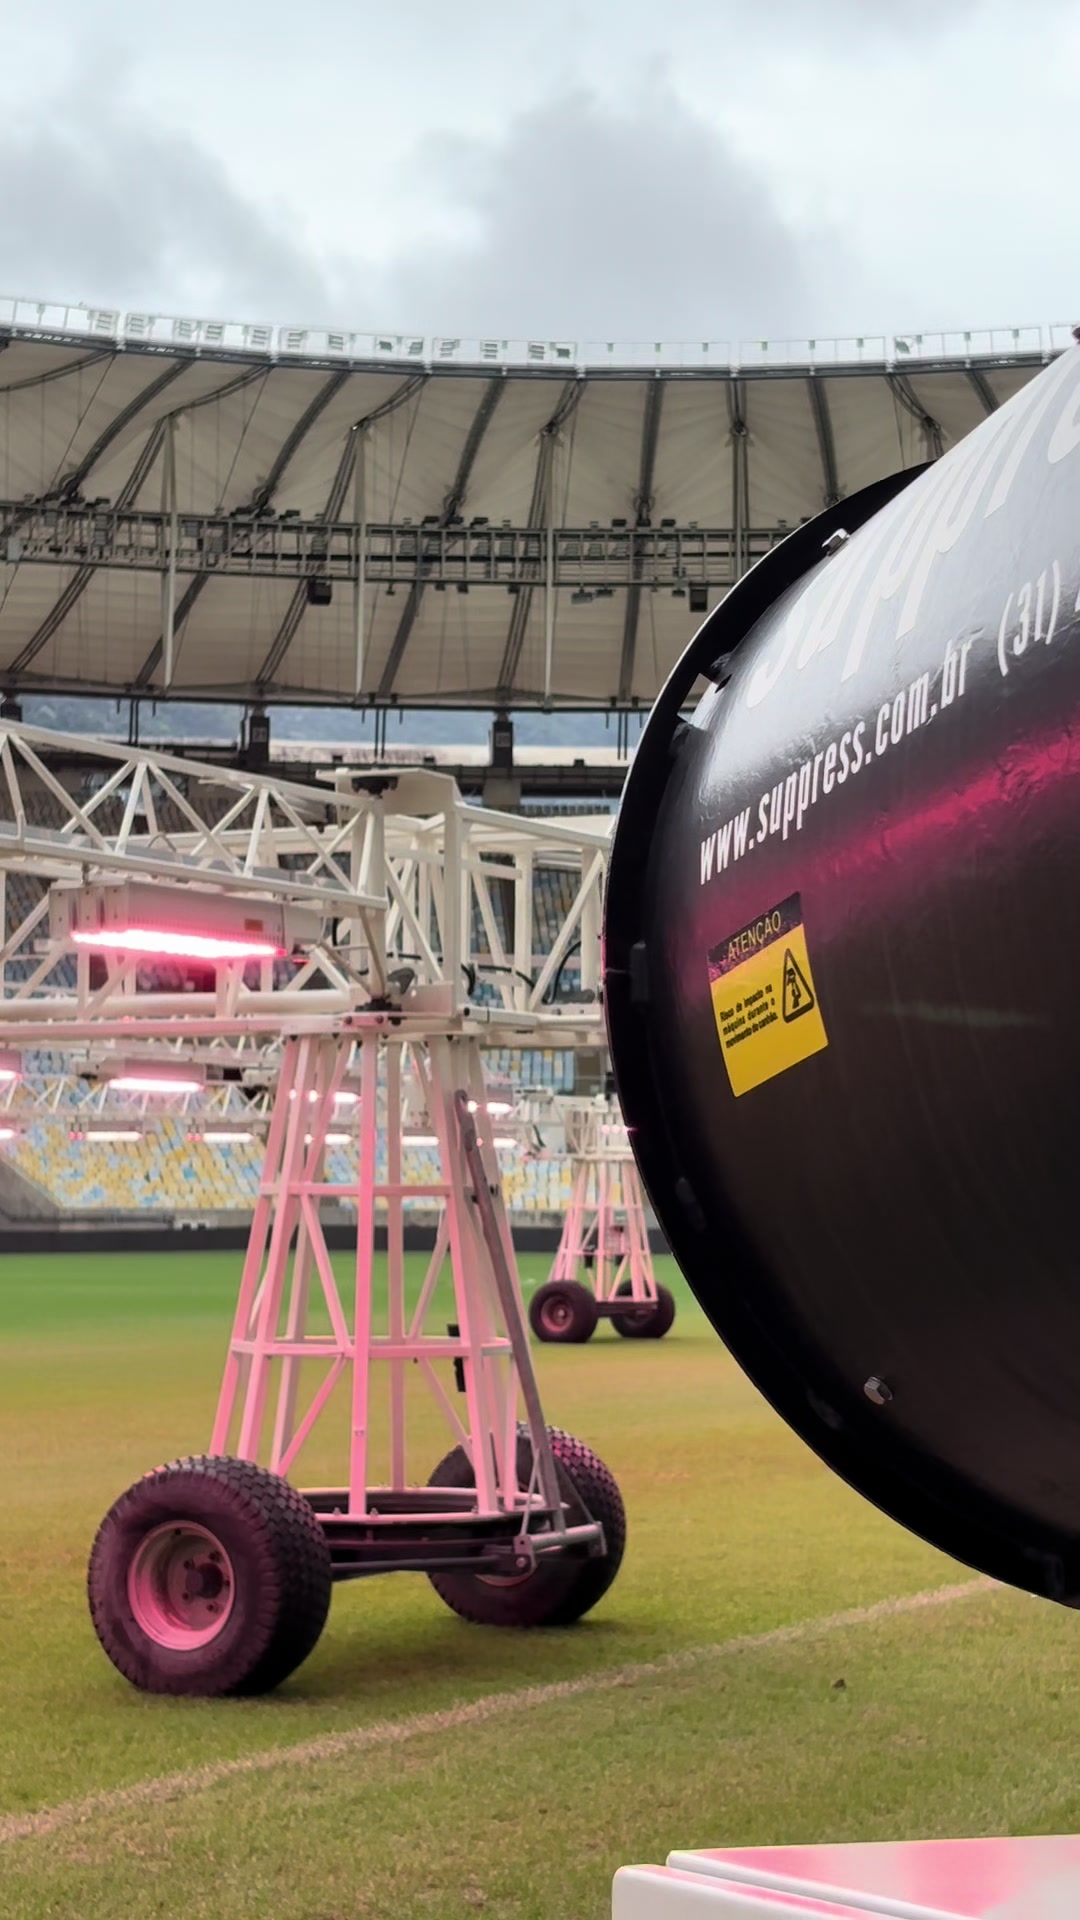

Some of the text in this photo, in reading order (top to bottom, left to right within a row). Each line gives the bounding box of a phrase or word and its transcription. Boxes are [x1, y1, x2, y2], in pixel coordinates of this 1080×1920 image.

[700, 559, 1060, 886] www.suppress.com.br (31)
[727, 910, 781, 962] ATENÇÃO
[720, 1008, 734, 1022] Risco
[736, 1003, 742, 1013] de
[743, 989, 763, 1008] impacto
[747, 1001, 769, 1020] durante
